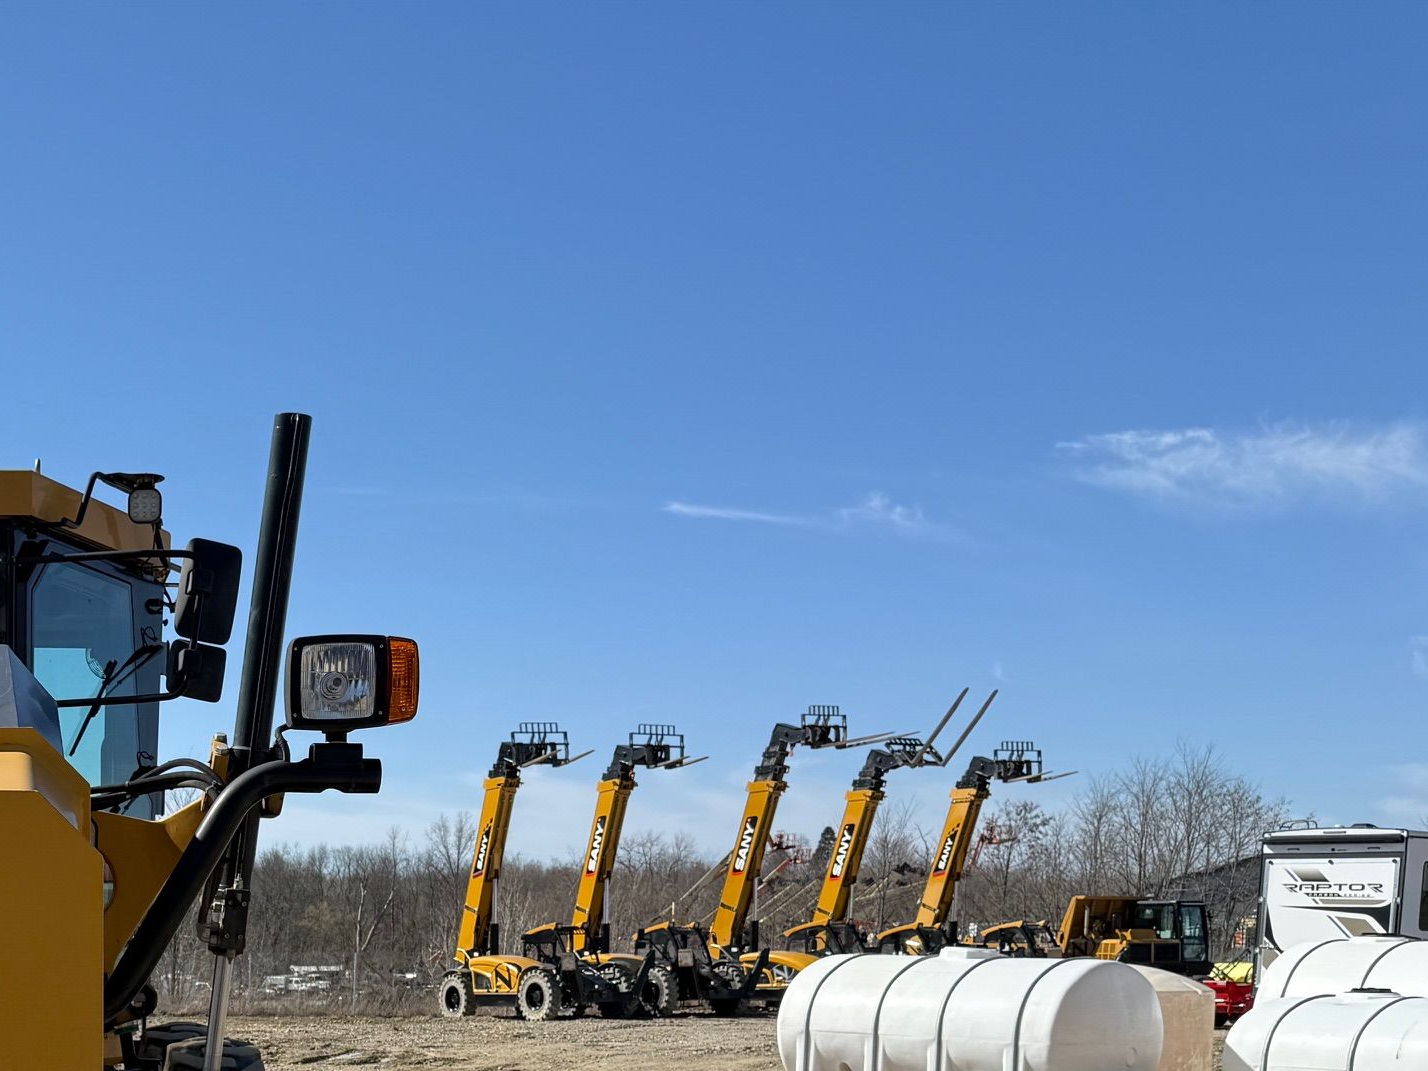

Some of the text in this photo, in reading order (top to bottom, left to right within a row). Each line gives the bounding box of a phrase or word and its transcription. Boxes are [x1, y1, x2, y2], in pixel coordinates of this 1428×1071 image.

[476, 834, 488, 870] SANY
[588, 822, 604, 872] SANY
[734, 822, 755, 871] SANY
[832, 829, 852, 876] SANY
[938, 837, 953, 870] SANY
[1282, 883, 1384, 893] RAPTOR
